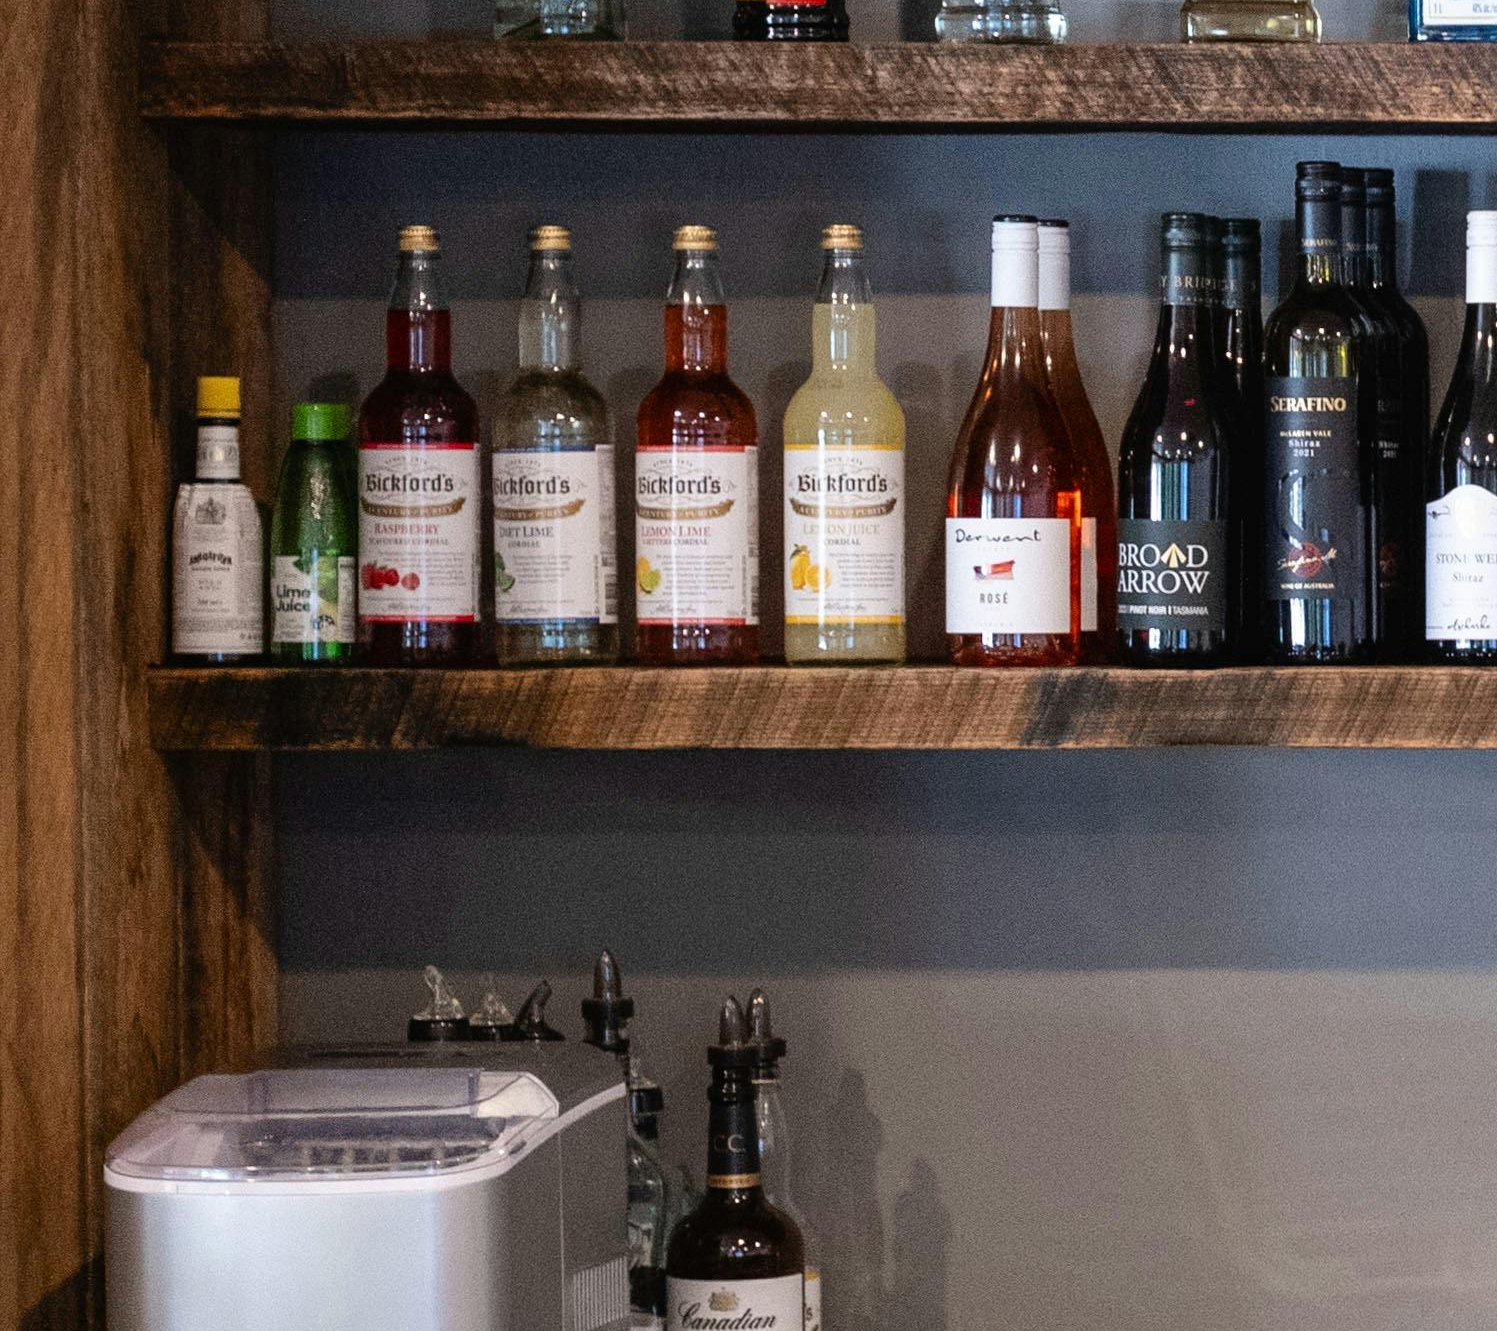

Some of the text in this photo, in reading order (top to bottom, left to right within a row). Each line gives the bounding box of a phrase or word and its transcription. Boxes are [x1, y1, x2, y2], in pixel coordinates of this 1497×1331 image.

[1270, 396, 1348, 413] SERAFINO
[365, 473, 454, 493] Bickford's
[638, 475, 722, 495] Bickford's
[797, 473, 888, 493] Bikford's
[374, 523, 440, 535] RASPBERRY
[523, 526, 554, 538] LIME
[678, 525, 711, 537] LIME
[803, 524, 882, 536] LEON JUICE
[954, 528, 1041, 544] Derwent
[1117, 569, 1210, 595] ARROW
[276, 584, 312, 598] Lime
[275, 600, 312, 612] Juice
[678, 1300, 777, 1331] Canadian
